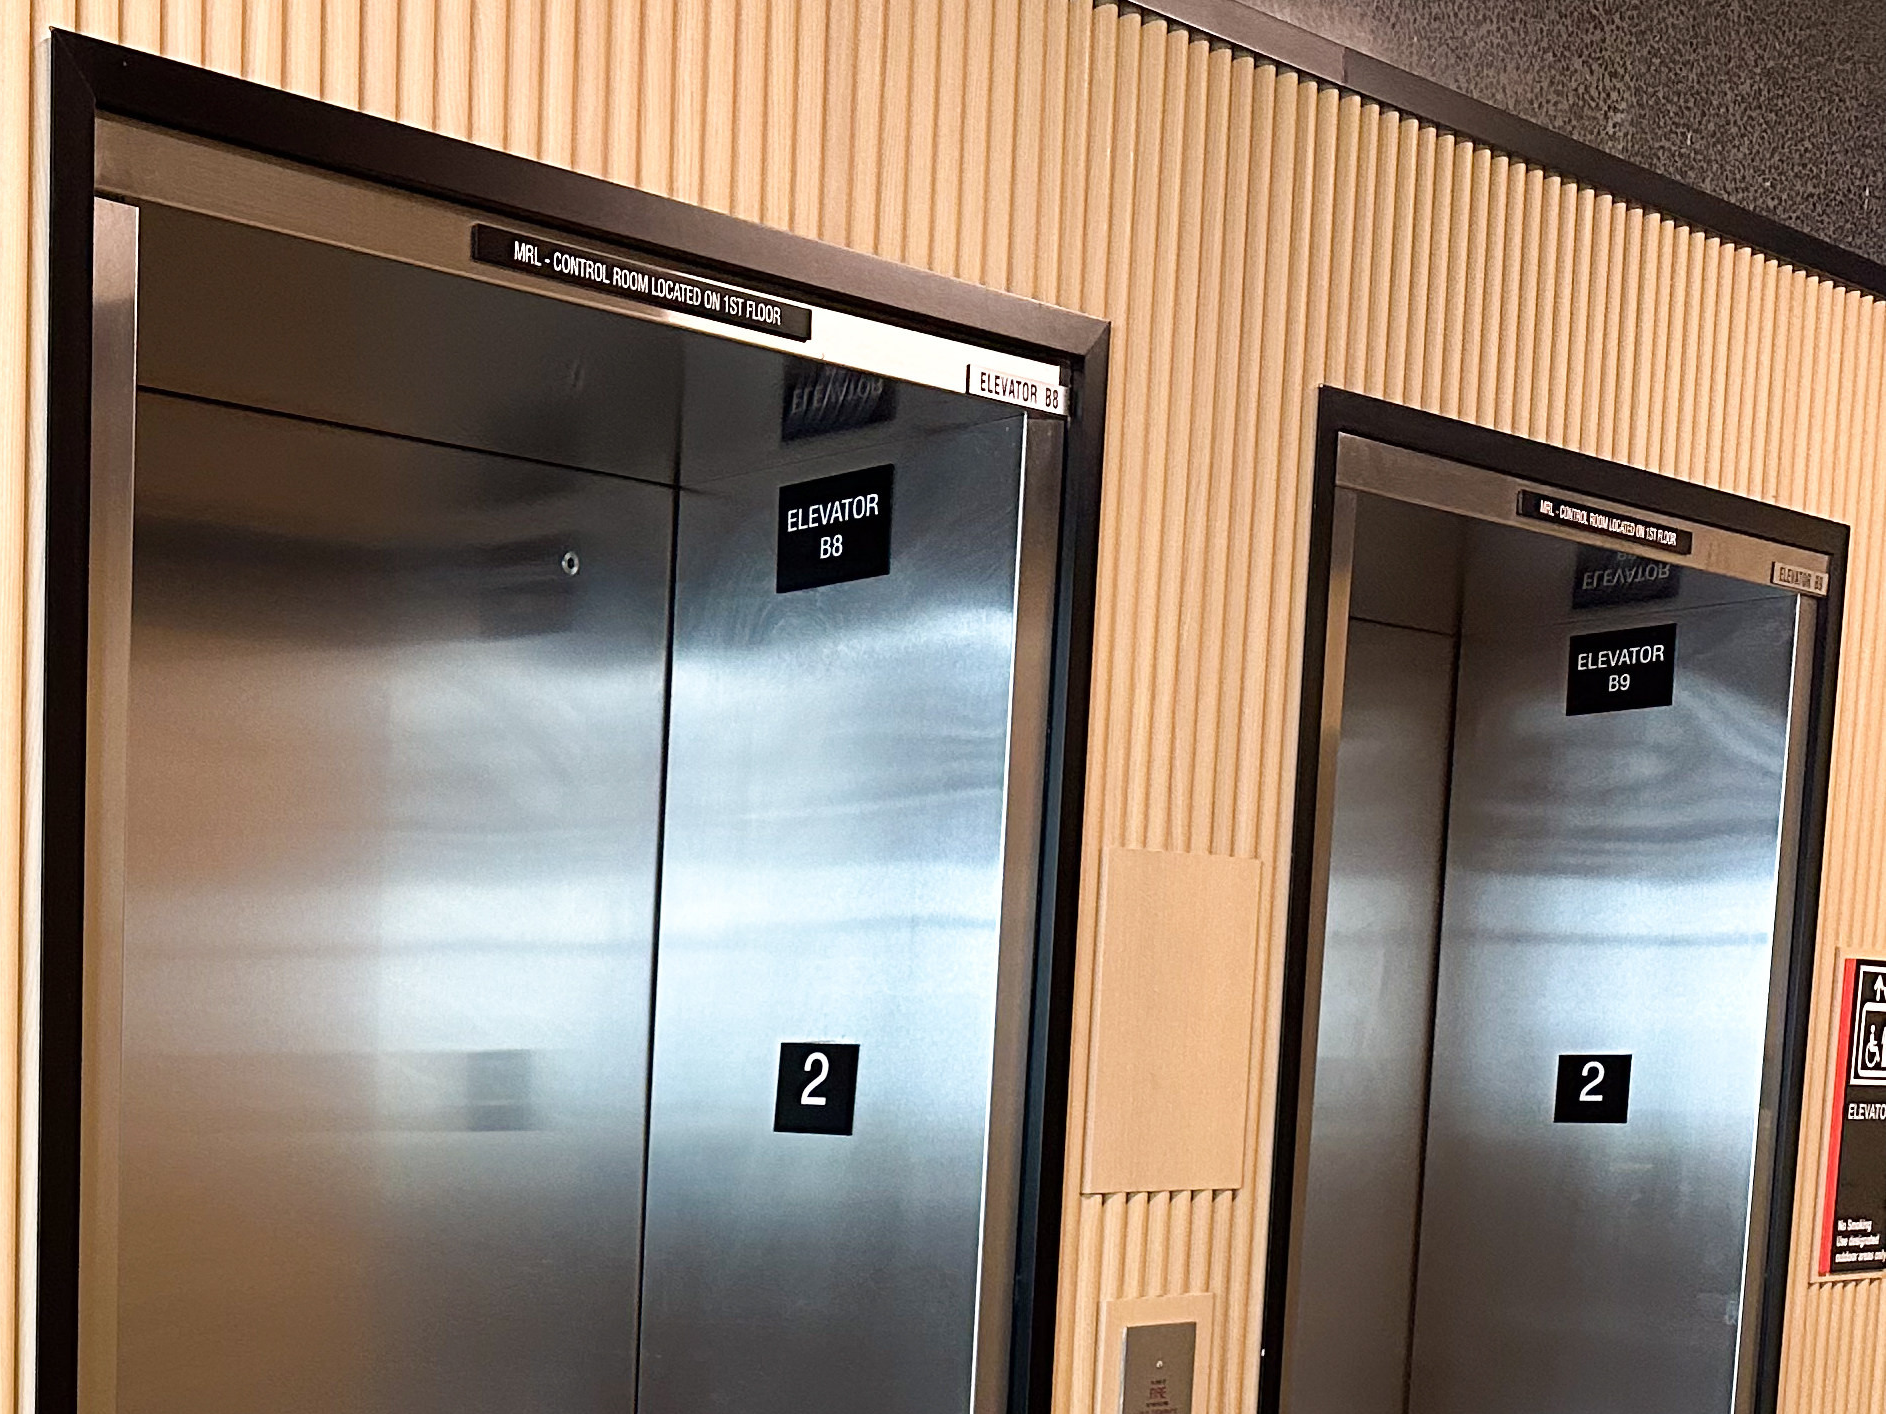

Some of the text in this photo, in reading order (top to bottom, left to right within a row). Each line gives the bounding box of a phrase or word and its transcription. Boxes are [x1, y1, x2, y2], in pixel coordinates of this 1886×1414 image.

[514, 240, 541, 267] MRL
[553, 251, 610, 284] CONTROL
[613, 267, 649, 294] ROOM
[651, 278, 701, 307] LOCATED
[704, 289, 720, 311] ON
[723, 295, 744, 318] 1ST
[746, 300, 782, 326] FLOOR
[980, 371, 1059, 409] ELEVATOR B8
[787, 493, 879, 532] ELEVATOR
[1559, 505, 1588, 525] CONTROL
[1589, 513, 1609, 530] ROOM
[1646, 527, 1657, 541] 1ST
[819, 534, 843, 559] B8
[1577, 644, 1665, 672] ELEVATOR
[1608, 674, 1630, 692] B9
[800, 1051, 829, 1106] 2
[1579, 1060, 1605, 1101] 2
